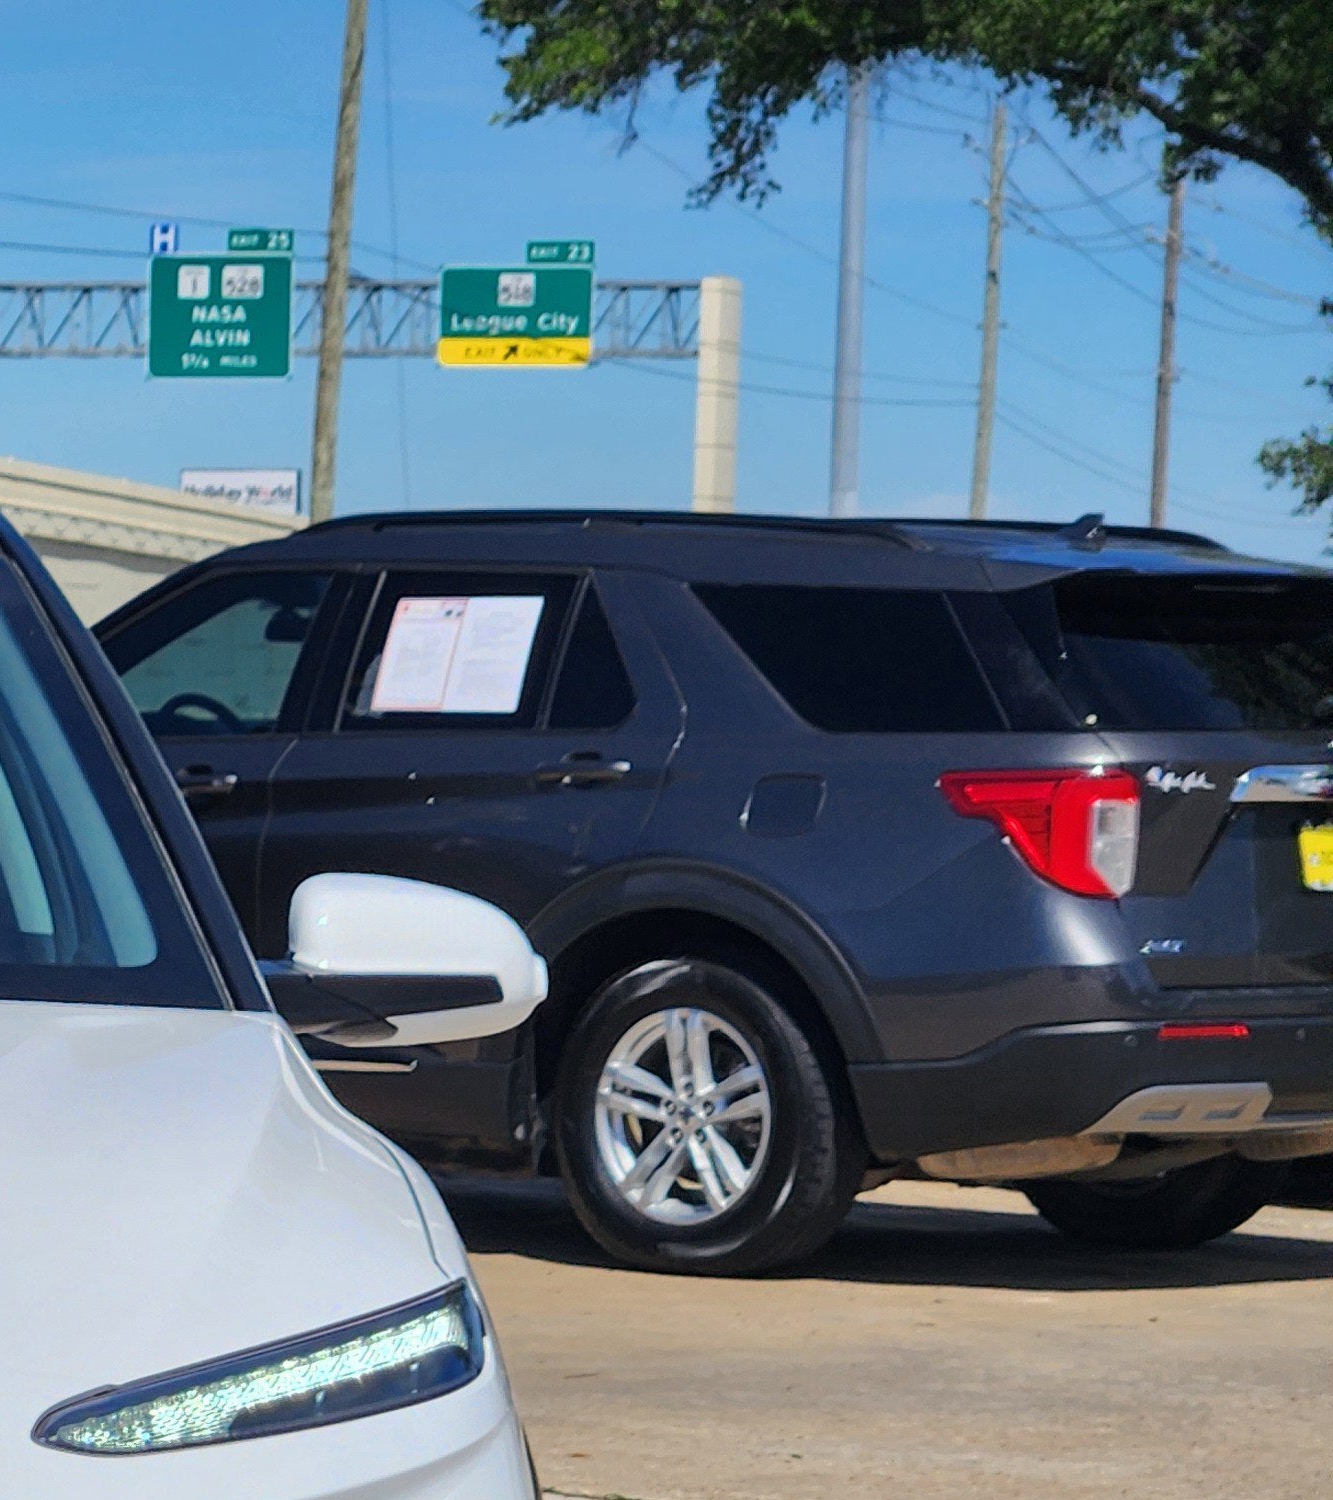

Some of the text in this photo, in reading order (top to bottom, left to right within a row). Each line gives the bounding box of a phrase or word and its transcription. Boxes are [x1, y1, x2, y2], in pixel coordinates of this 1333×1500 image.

[191, 303, 247, 324] NASA
[449, 311, 580, 337] League City
[189, 328, 251, 348] ALVIN
